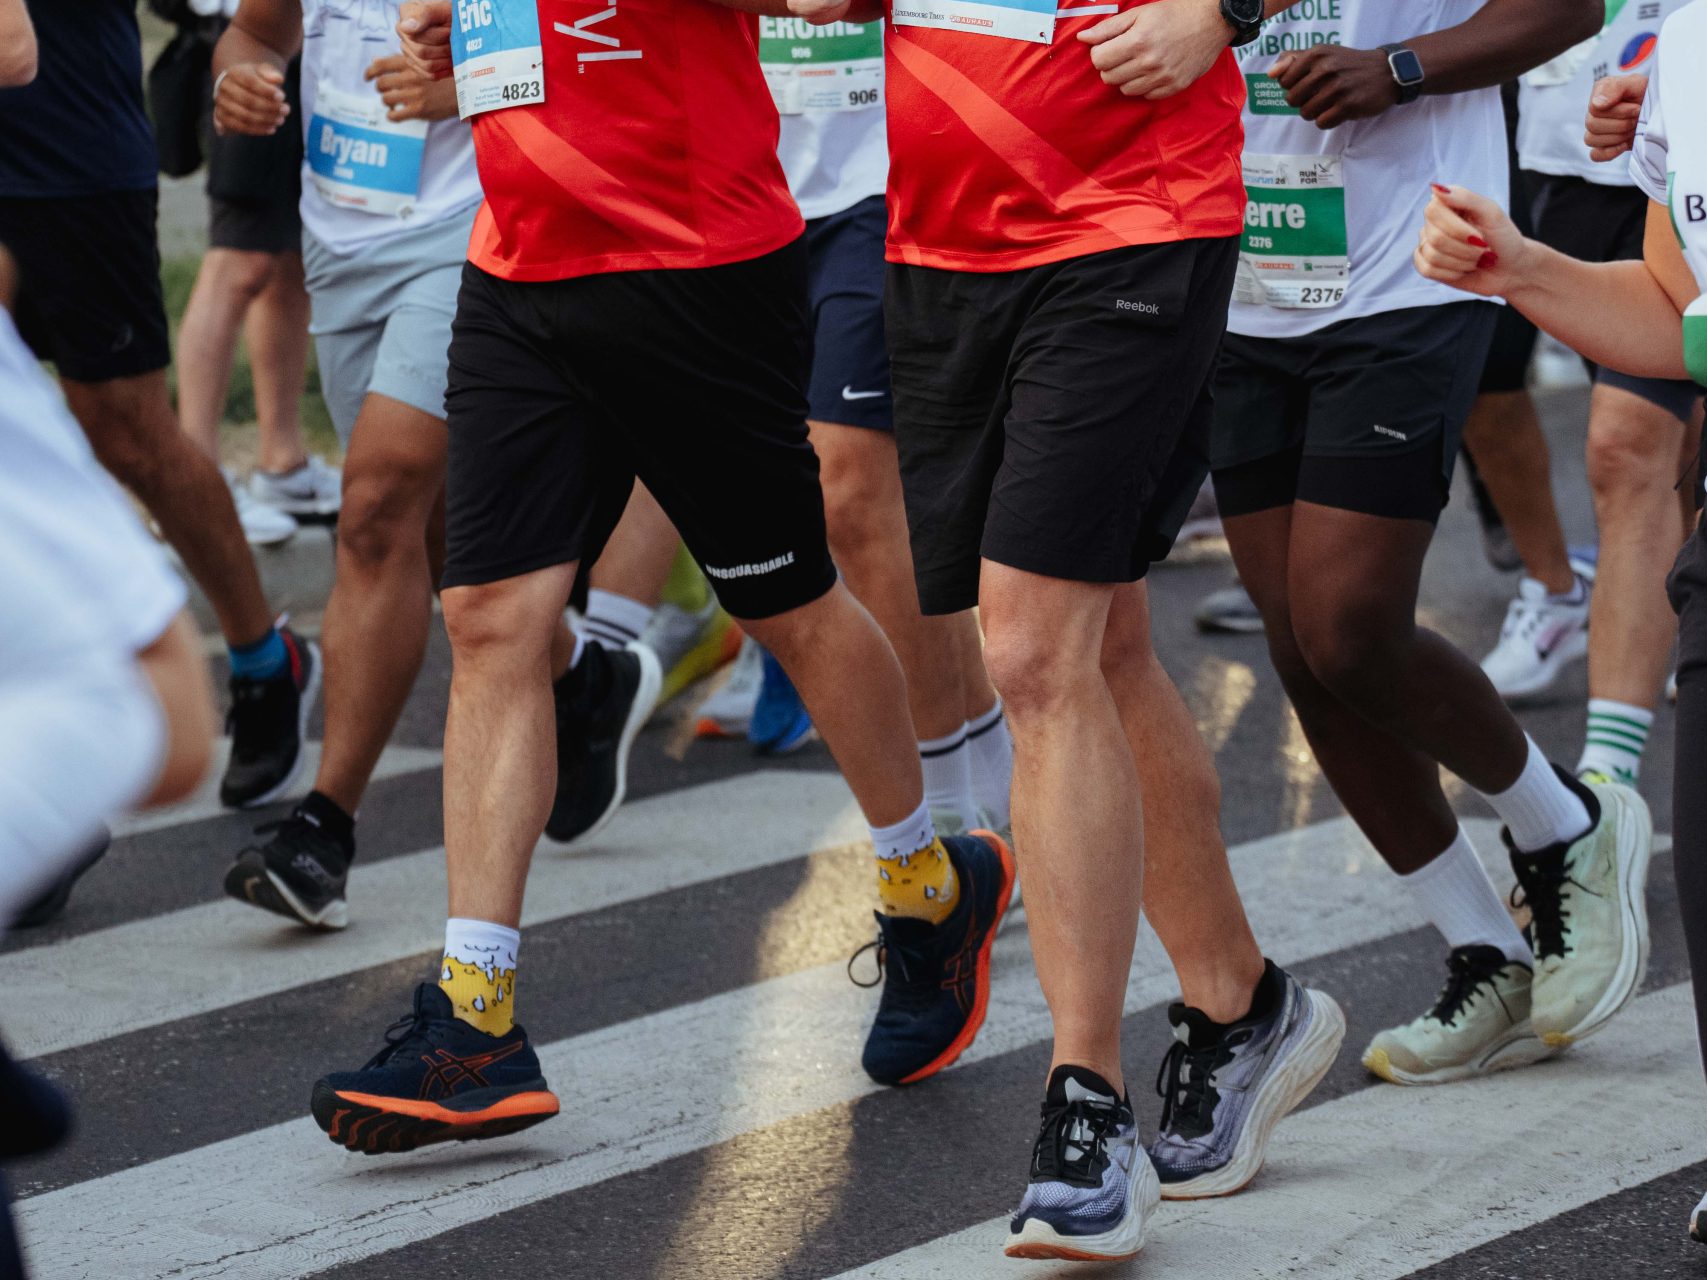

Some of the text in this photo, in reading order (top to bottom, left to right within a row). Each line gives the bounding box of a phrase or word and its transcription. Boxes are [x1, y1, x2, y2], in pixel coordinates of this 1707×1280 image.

[502, 81, 541, 101] 4823
[849, 89, 878, 105] 906
[1244, 200, 1306, 229] erre
[1249, 236, 1273, 248] 2376
[1301, 287, 1344, 303] 2376
[1116, 299, 1160, 315] Reebok
